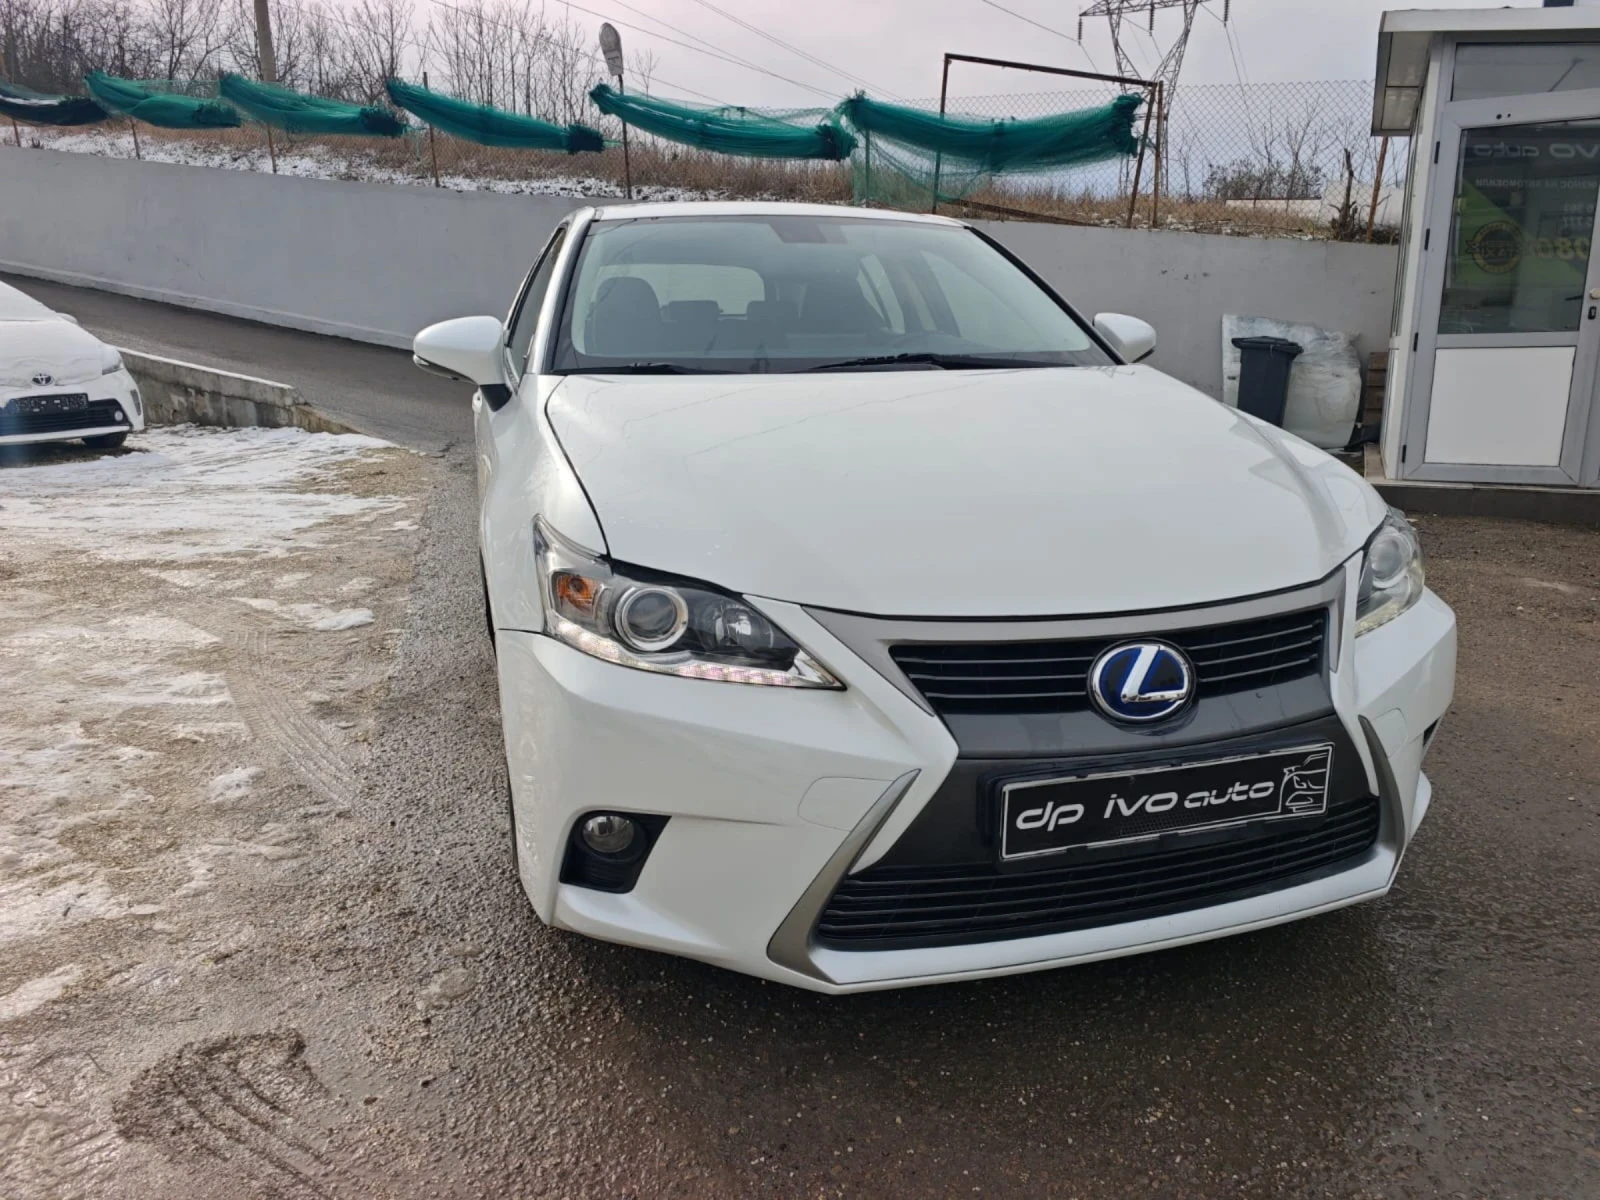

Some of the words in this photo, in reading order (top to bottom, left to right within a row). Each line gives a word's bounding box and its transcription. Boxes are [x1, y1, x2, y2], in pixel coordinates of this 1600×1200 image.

[1015, 801, 1085, 832] dp
[1103, 793, 1179, 819] ivo
[1183, 780, 1276, 809] auto
